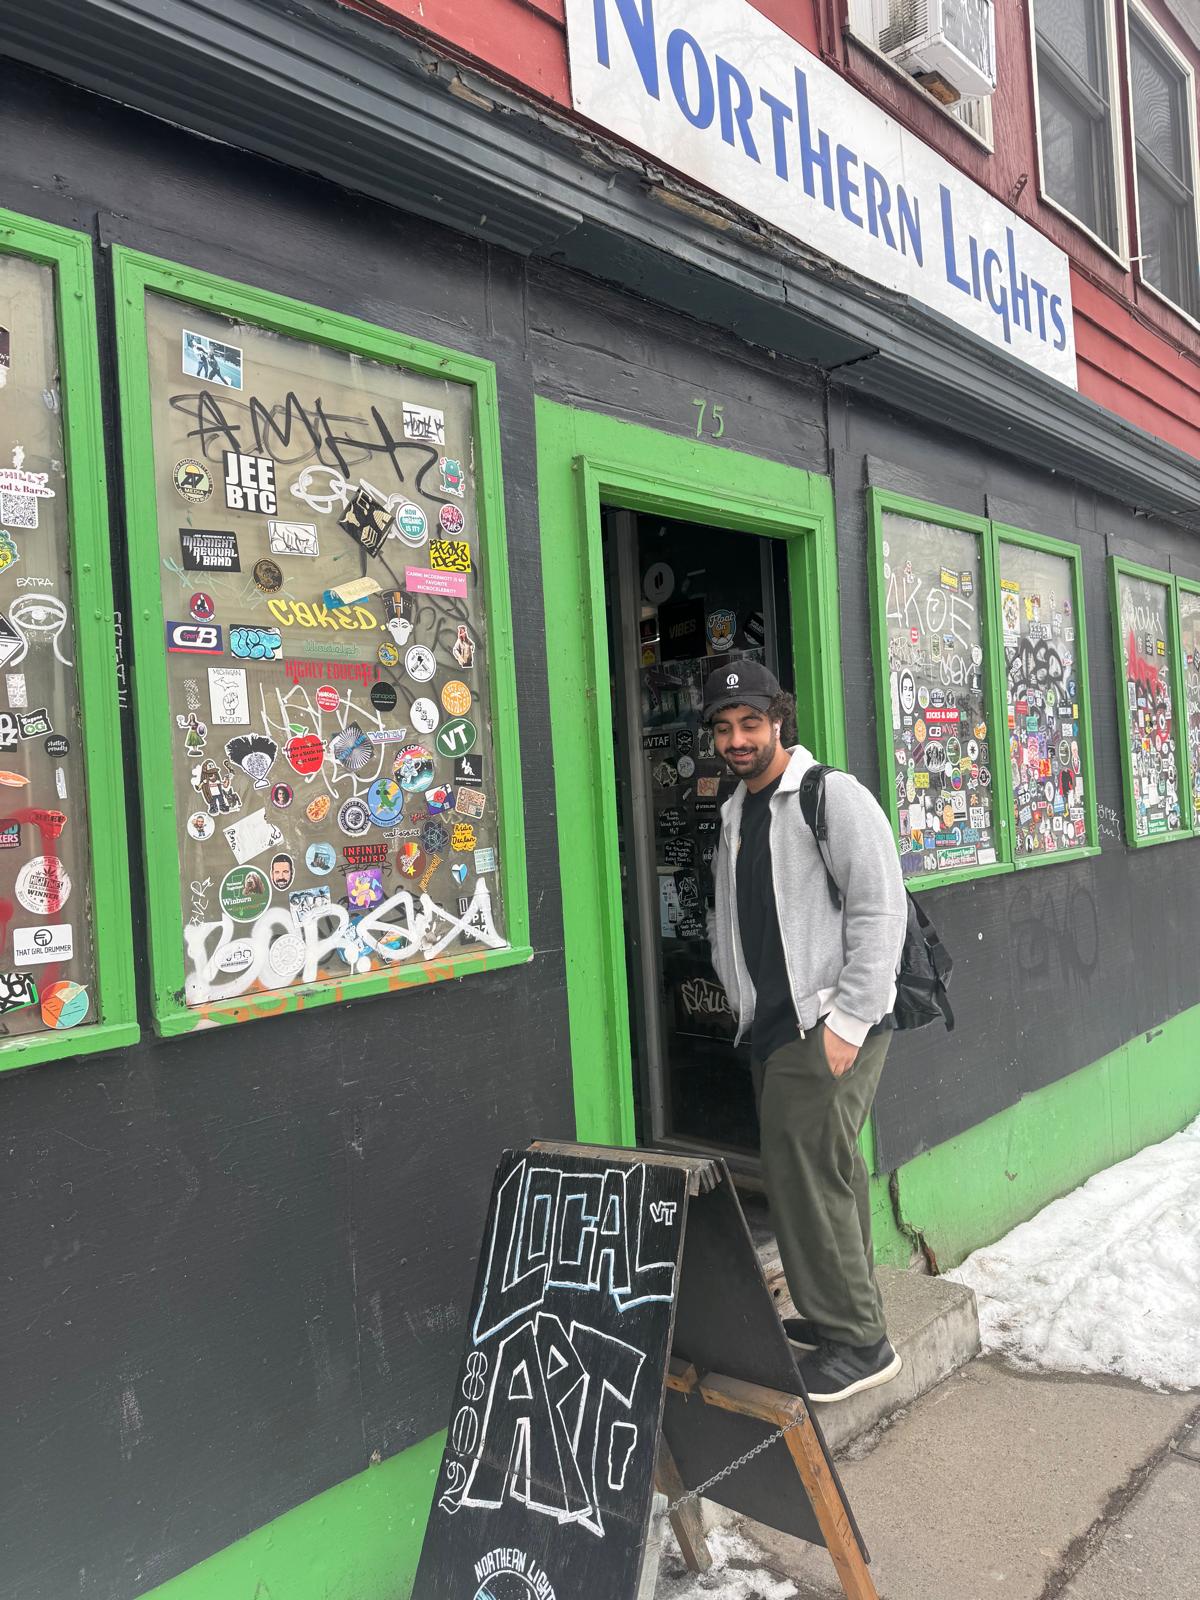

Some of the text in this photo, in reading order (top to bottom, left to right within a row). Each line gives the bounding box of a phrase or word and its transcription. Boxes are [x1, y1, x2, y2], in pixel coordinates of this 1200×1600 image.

[691, 398, 724, 438] 75
[223, 452, 273, 490] JEE
[226, 485, 276, 511] BTC
[183, 535, 235, 552] MIDNIGHT
[193, 546, 237, 564] REVIVAL
[203, 556, 232, 567] BAND
[16, 576, 54, 588] EXTRA
[669, 618, 696, 640] VIBES
[709, 611, 735, 628] Float
[173, 625, 217, 649] CB
[926, 711, 941, 719] KICKS
[946, 711, 959, 719] DRIP
[441, 723, 468, 751] VT
[343, 844, 388, 856] INFINITE
[354, 855, 386, 864] THIRD
[27, 888, 59, 900] WINNER
[16, 944, 72, 957] THAT GIRL DRUMMER
[650, 1200, 677, 1226] VT
[473, 1158, 676, 1346] LOCAL
[461, 1311, 647, 1538] ART
[473, 1547, 527, 1583] NORTHERN
